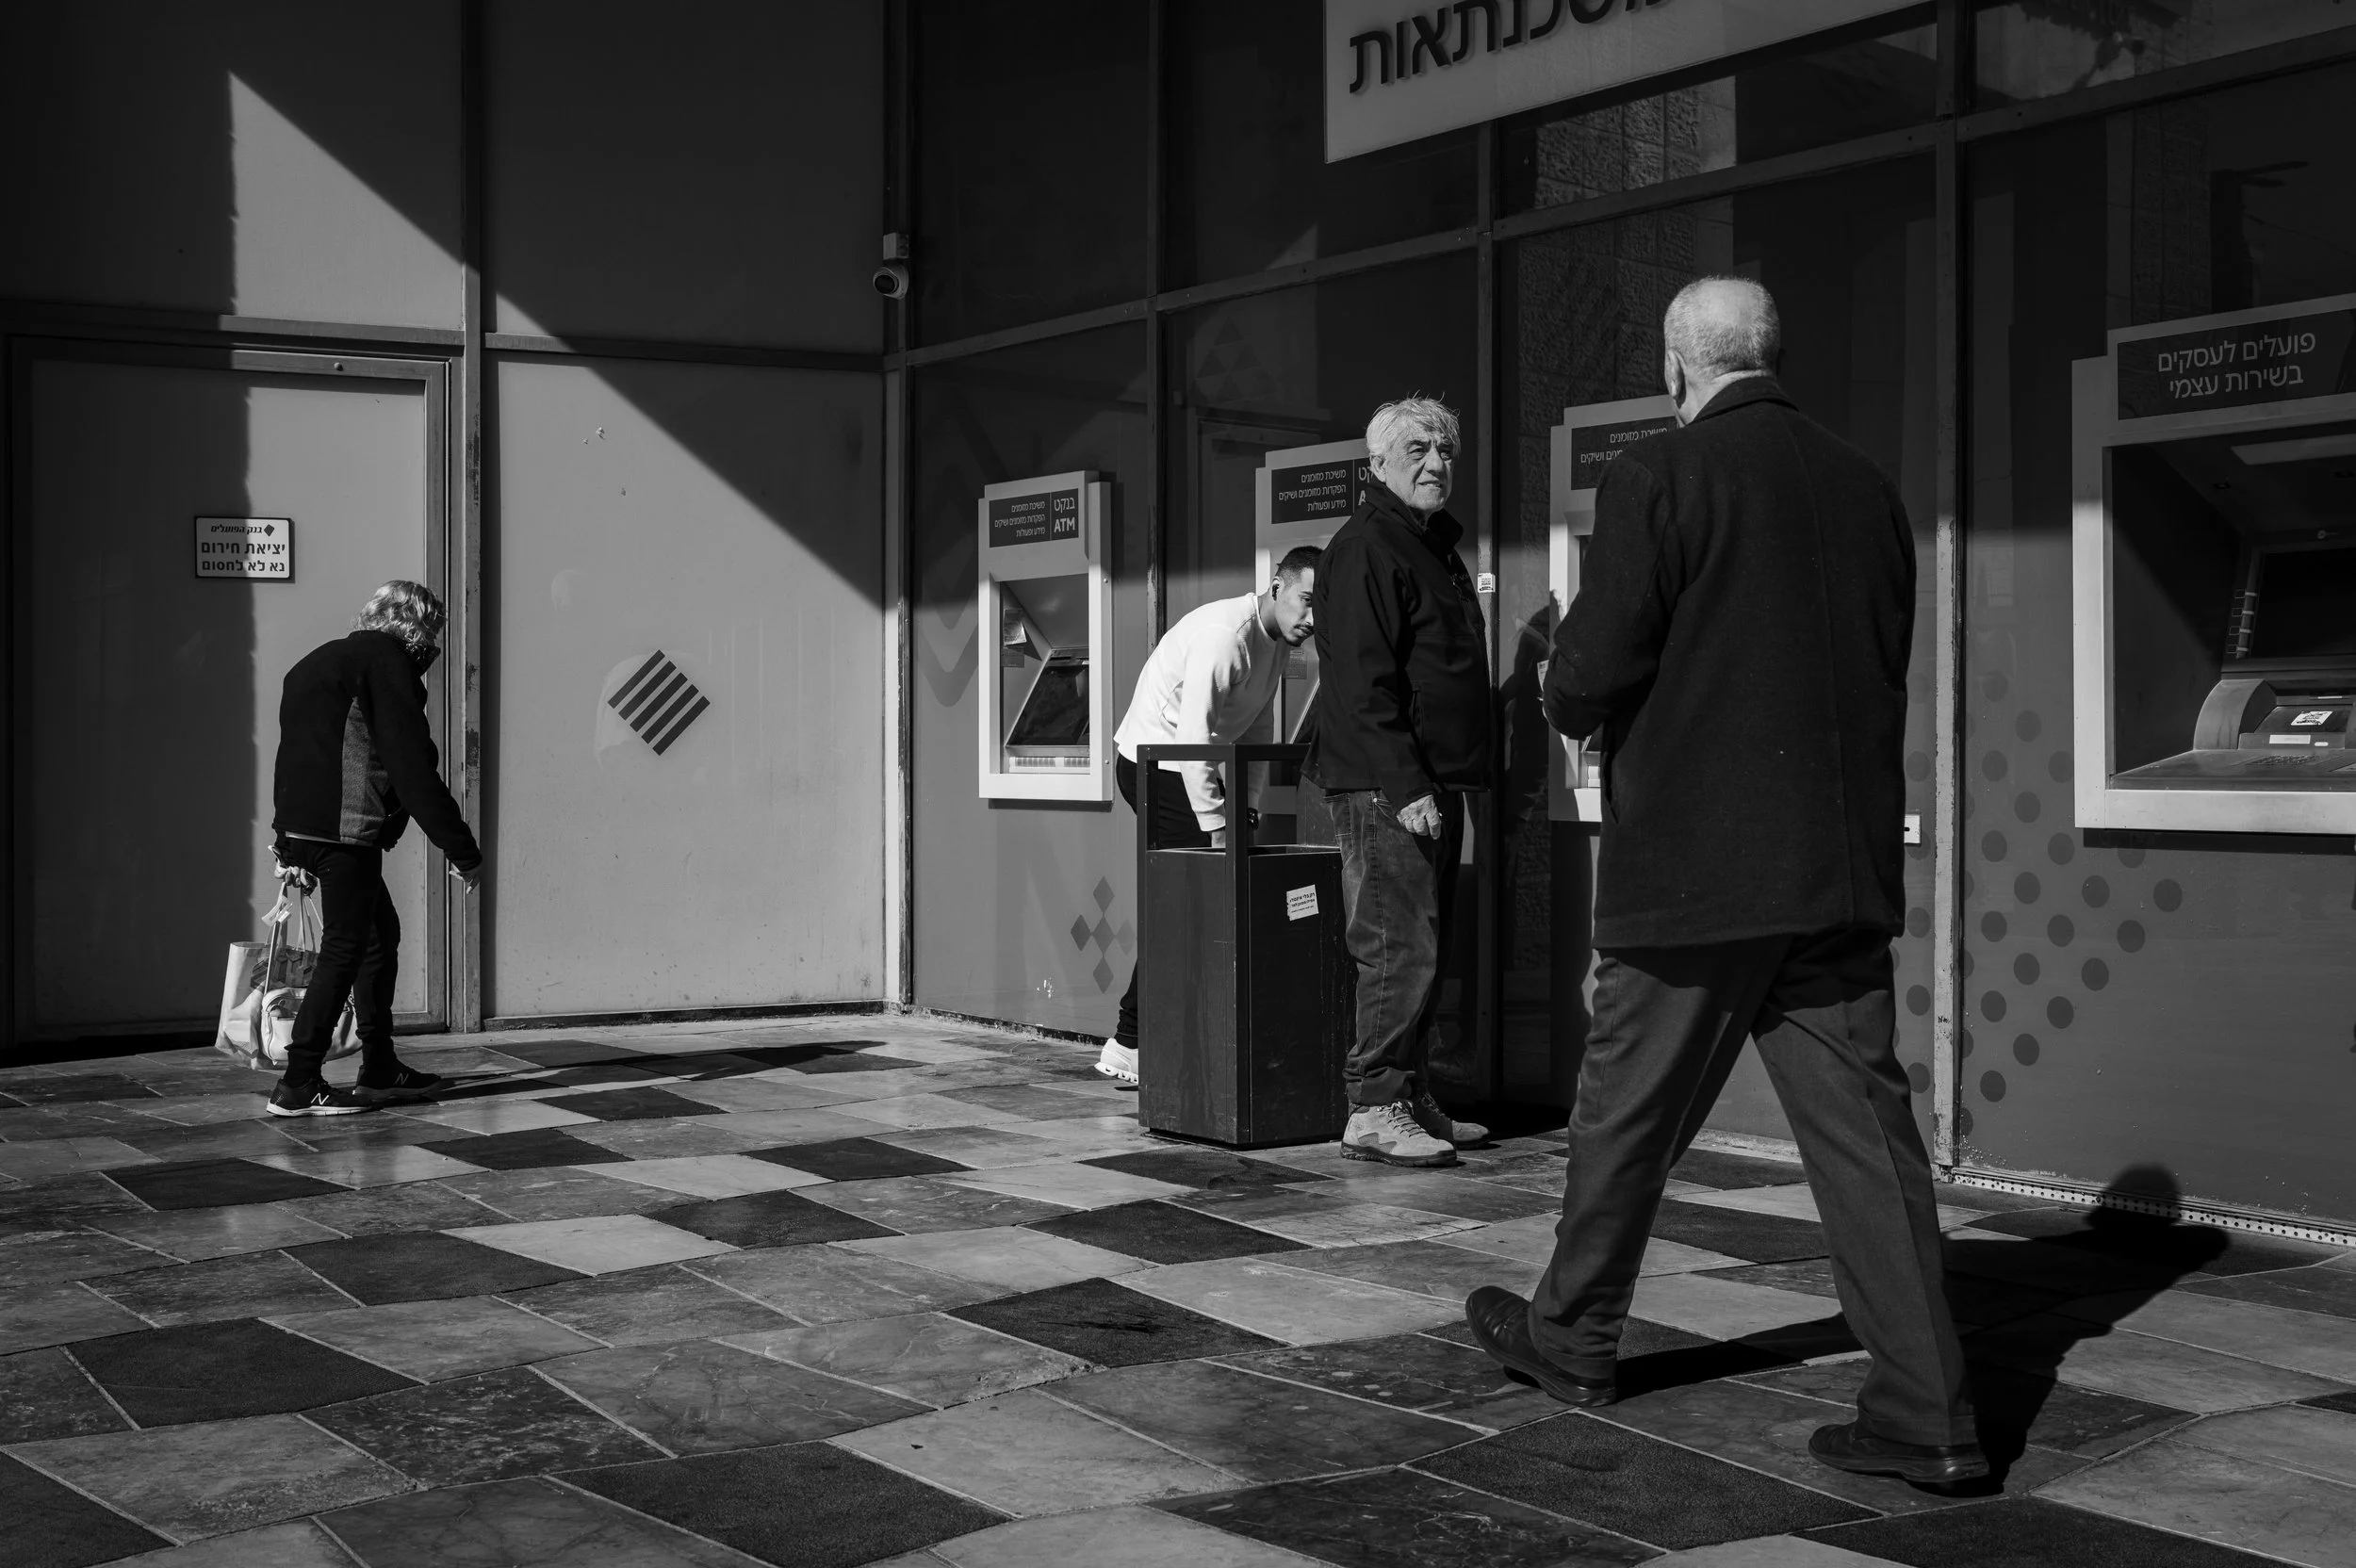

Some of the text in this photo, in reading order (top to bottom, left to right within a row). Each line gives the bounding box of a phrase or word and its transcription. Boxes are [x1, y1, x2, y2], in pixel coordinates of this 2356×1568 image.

[2158, 333, 2316, 374] פועלים לעסקים
[2169, 365, 2304, 400] בשירות עצמי
[1610, 431, 1639, 443] מזומנים
[1580, 451, 1604, 465] ושיקים
[1301, 469, 1346, 483] משיכת מזומנים
[1299, 487, 1321, 498] מזומנים
[1322, 484, 1346, 496] הפקדות
[1054, 498, 1075, 513] בנקט
[1331, 499, 1346, 509] מידע
[210, 524, 263, 534] בנק הפועלים
[1054, 517, 1075, 532] ATM
[201, 542, 285, 554] יציאת חירום
[202, 559, 285, 572] נא לא לחסום
